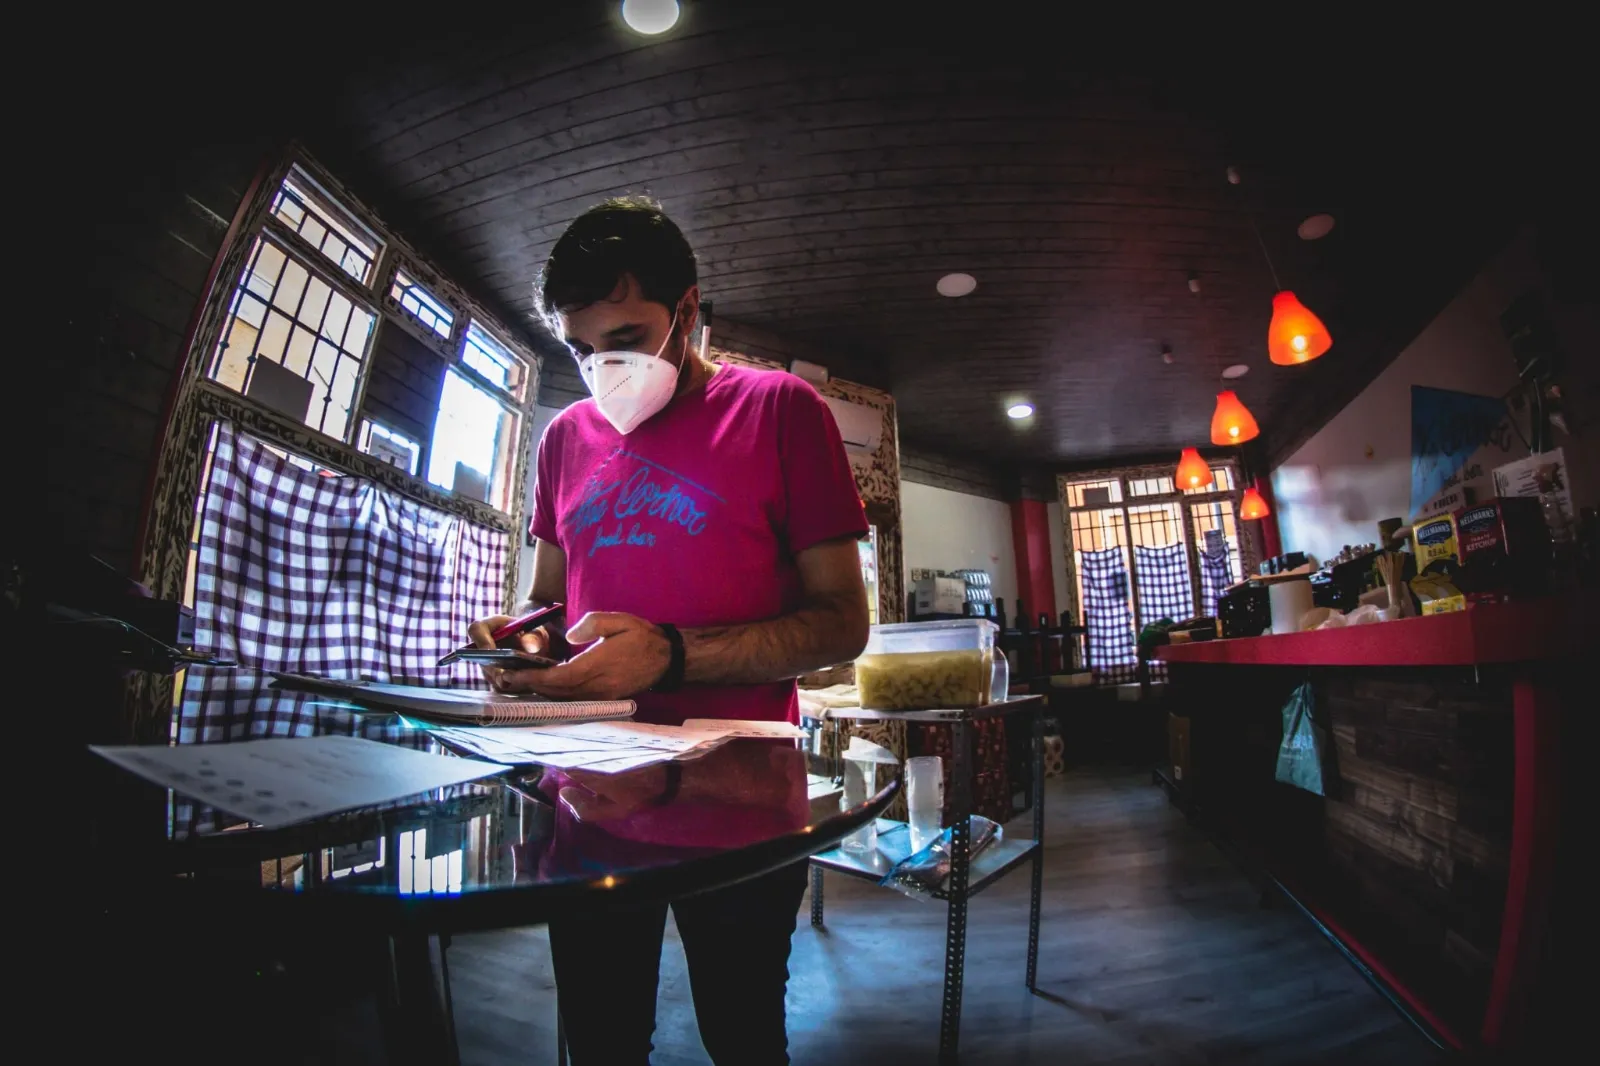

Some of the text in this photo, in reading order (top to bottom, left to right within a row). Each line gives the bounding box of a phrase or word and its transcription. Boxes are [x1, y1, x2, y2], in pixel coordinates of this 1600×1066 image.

[613, 465, 708, 536] Corner
[587, 521, 657, 558] food bar
[1428, 547, 1447, 558] REAL
[1466, 537, 1498, 553] KETCHUP
